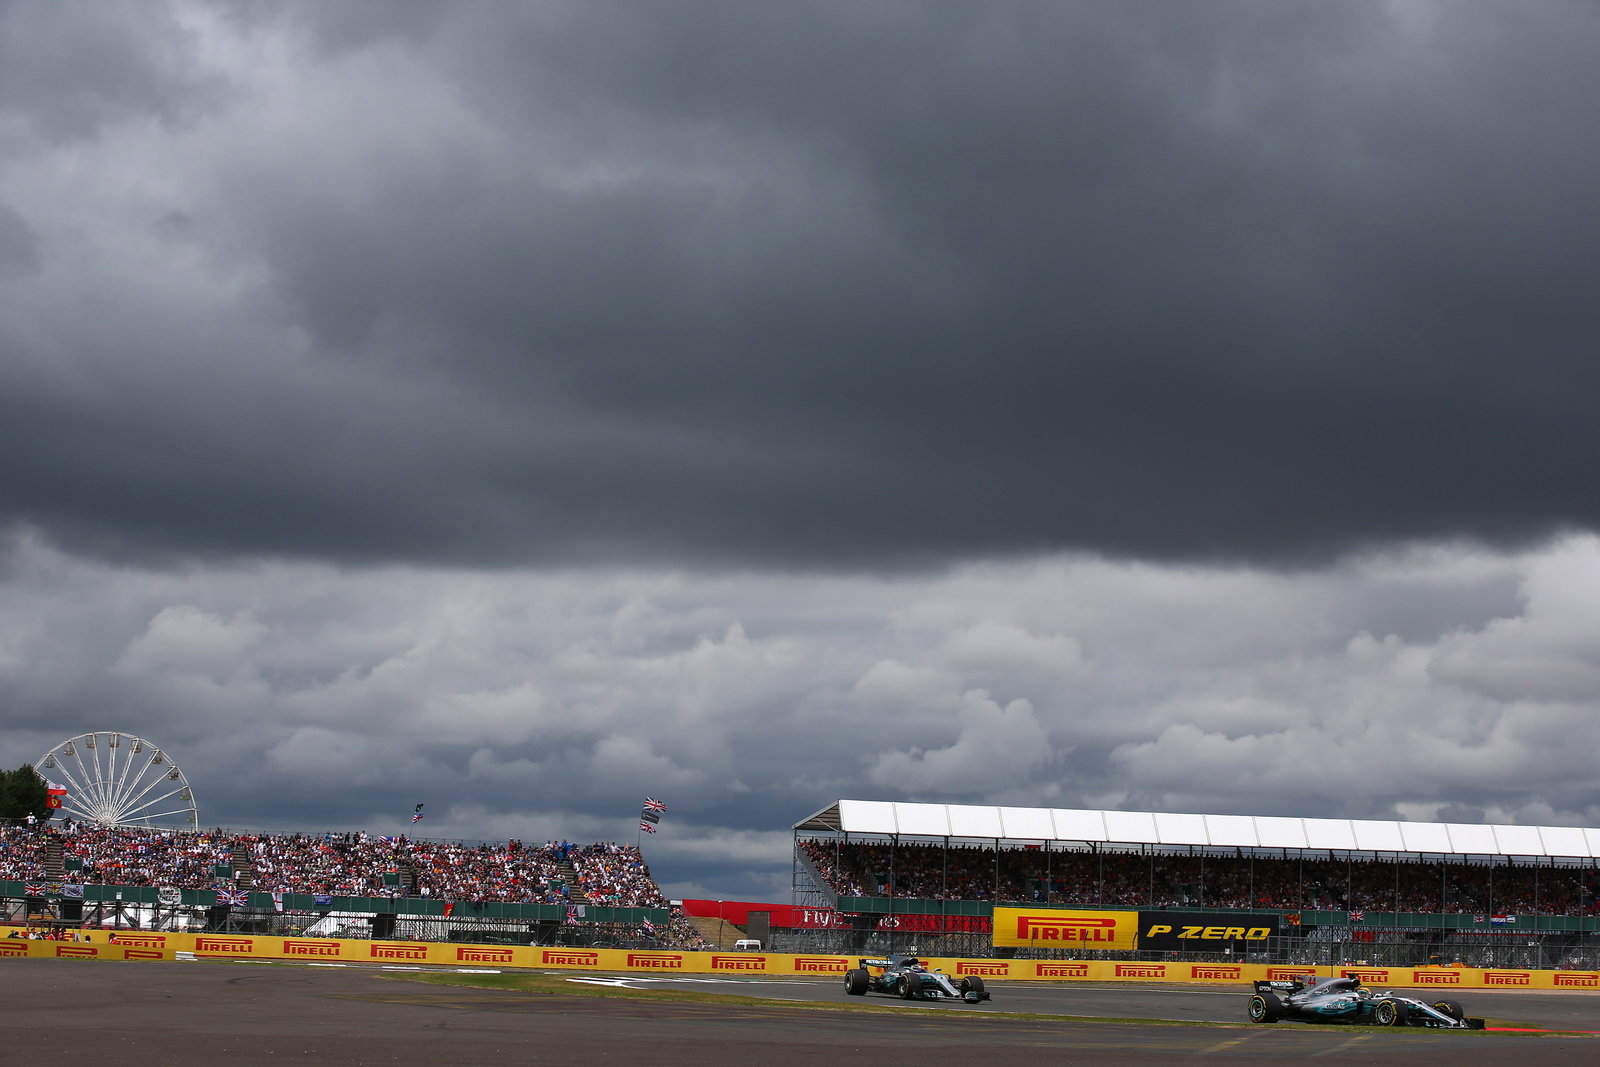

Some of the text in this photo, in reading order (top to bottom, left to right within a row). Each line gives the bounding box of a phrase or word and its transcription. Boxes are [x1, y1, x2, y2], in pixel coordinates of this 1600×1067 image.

[804, 910, 830, 927] Fly
[1017, 916, 1116, 942] PIRELLI
[1146, 925, 1271, 940] P ZERO
[195, 938, 253, 952] PIRELLI
[284, 941, 340, 956] PIRELLI
[371, 944, 427, 959] PIRELLI
[457, 948, 513, 962] PIRELLI
[543, 951, 598, 965] PIRELLI
[627, 954, 682, 968] PIRELLI
[712, 956, 766, 970] PIRELLI
[795, 958, 848, 972] PIRELLI
[957, 962, 1009, 976] PIRELLI
[1036, 964, 1088, 977] PIRELLI
[1115, 965, 1166, 978] PIRELLI
[1191, 966, 1241, 980] PIRELLI
[1413, 971, 1460, 984] PIRELLI
[1308, 977, 1316, 987] 44
[1484, 973, 1530, 985] PIRELLI
[1554, 974, 1599, 987] PIRELLI
